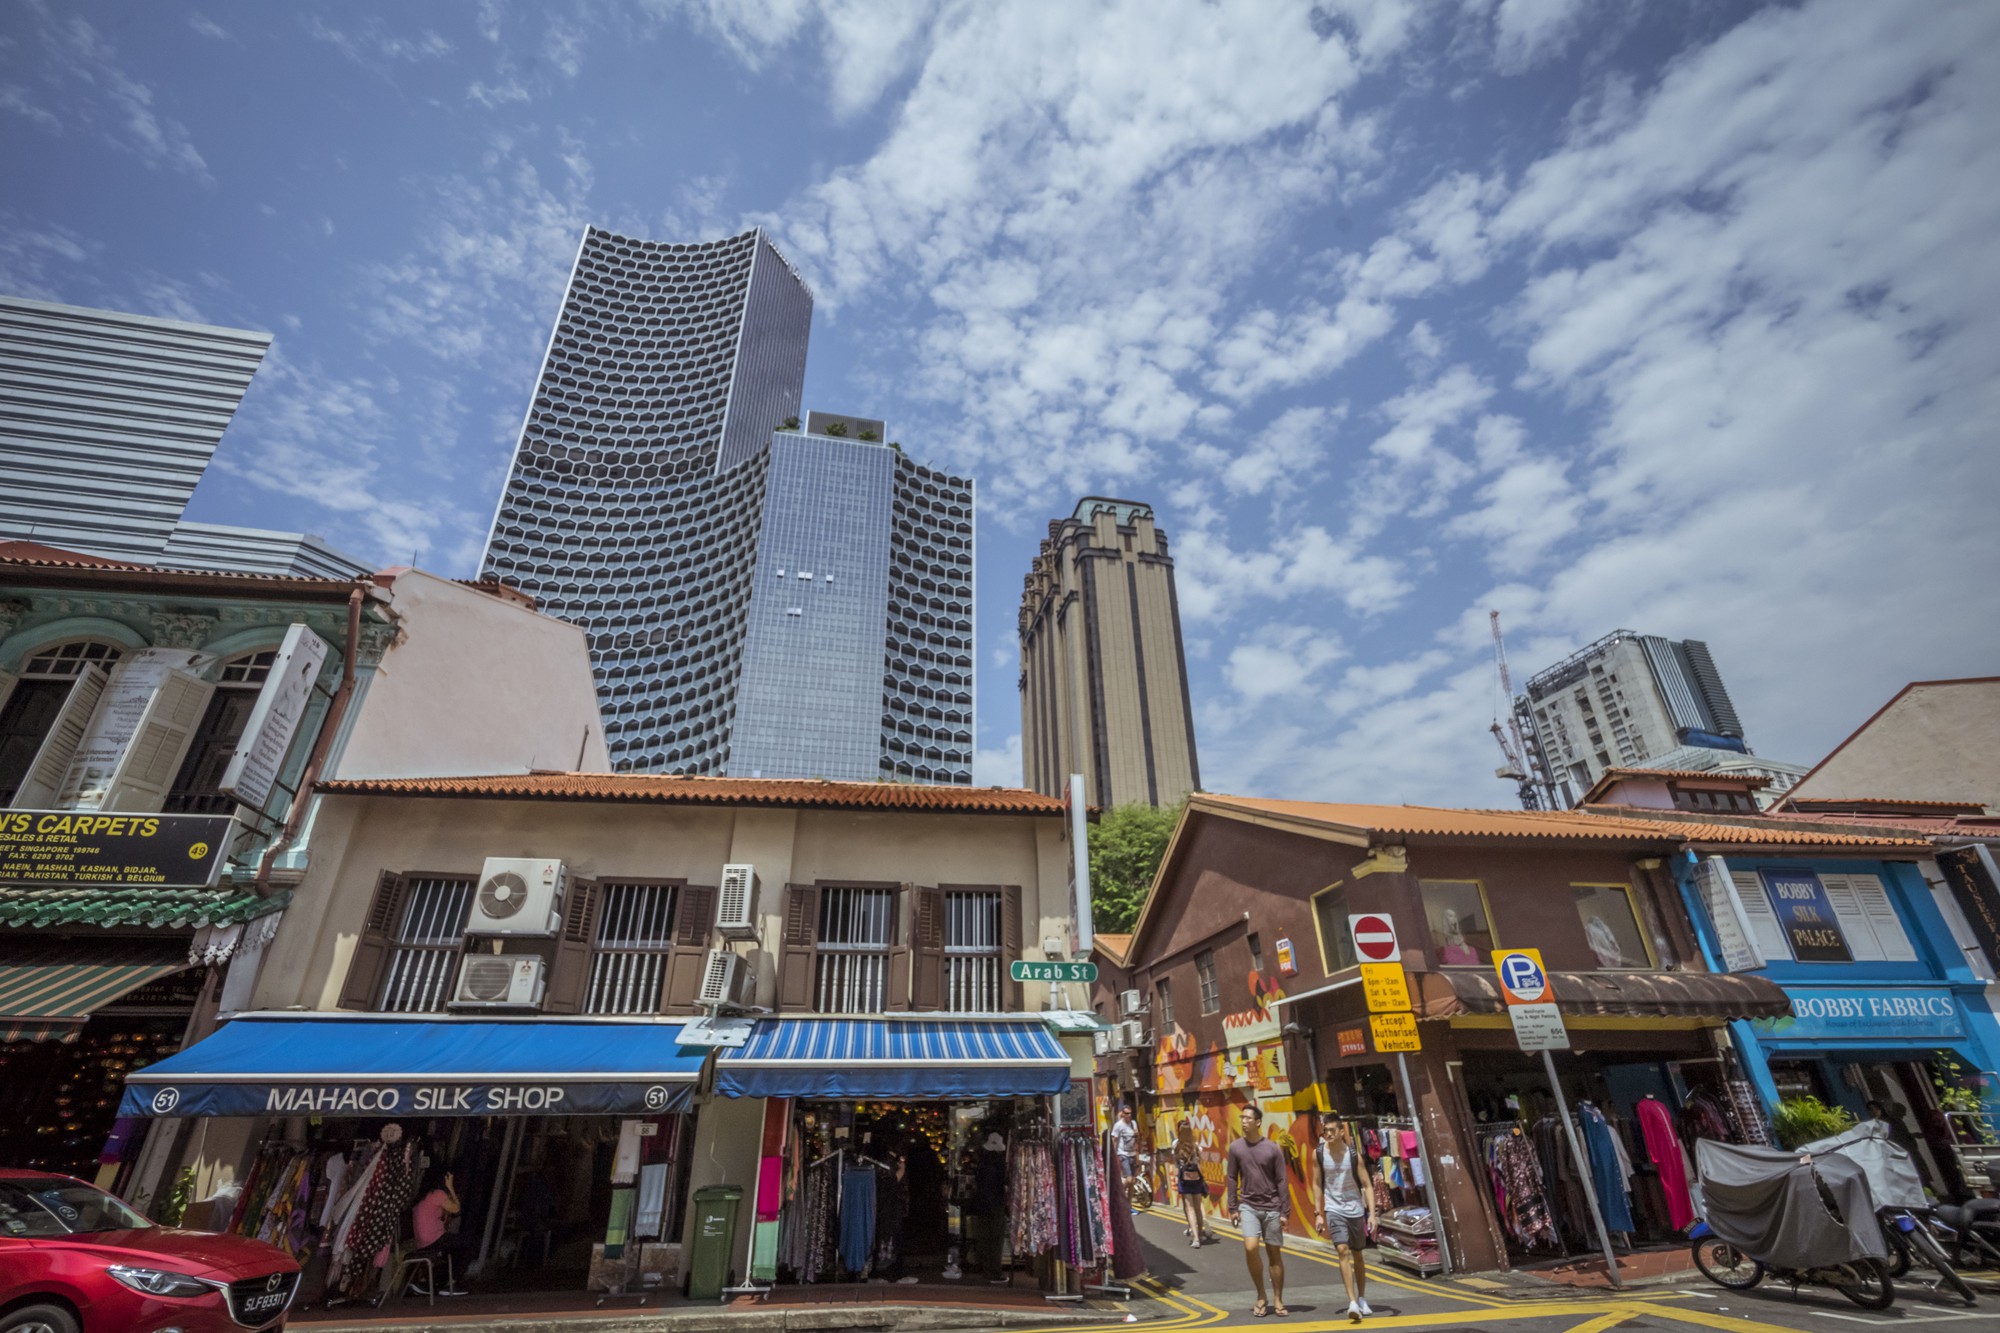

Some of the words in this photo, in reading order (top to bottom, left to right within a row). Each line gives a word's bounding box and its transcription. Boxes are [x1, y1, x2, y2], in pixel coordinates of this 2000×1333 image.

[36, 815, 160, 837] CARPETS
[45, 834, 79, 843] RETAIL
[19, 845, 70, 853] SINGAPORE
[190, 846, 206, 856] 49
[35, 863, 76, 872] MASHAD,
[79, 865, 120, 874] KASHAN,
[123, 866, 158, 874] BIDJAR,
[23, 872, 69, 880] PAKISTAN,
[1775, 882, 1816, 900] BOBBY
[1792, 905, 1822, 922] SILK
[1793, 928, 1840, 947] PALACE
[1020, 964, 1063, 979] Arab
[1070, 965, 1089, 980] St
[1506, 957, 1536, 989] P
[1370, 988, 1380, 996] Sat
[1390, 988, 1401, 996] Sun
[1793, 998, 1866, 1018] BOBBY
[1869, 997, 1954, 1017] FABRICS
[1380, 1016, 1406, 1028] Except
[1374, 1028, 1418, 1038] Authorised
[1382, 1040, 1415, 1050] Vehicles
[157, 1093, 175, 1107] 51
[266, 1088, 399, 1111] MAHACO
[413, 1088, 473, 1110] SILK
[486, 1087, 564, 1110] SHOP
[649, 1092, 665, 1104] 51
